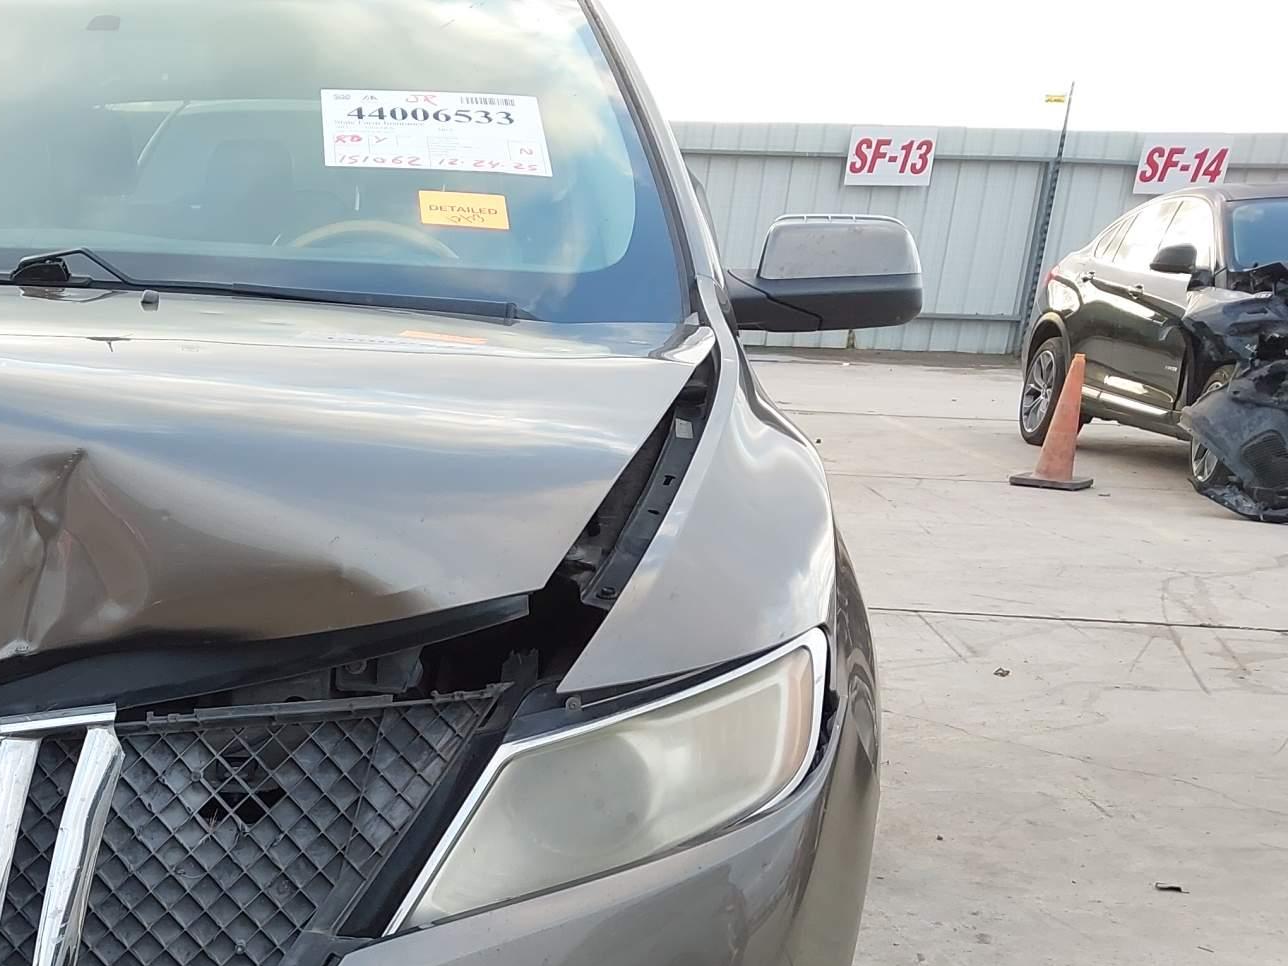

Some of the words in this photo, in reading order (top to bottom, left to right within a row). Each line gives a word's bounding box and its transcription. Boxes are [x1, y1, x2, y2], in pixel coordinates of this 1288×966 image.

[347, 106, 515, 126] 44006533
[849, 138, 933, 175] SF-13
[1139, 147, 1229, 183] SF-14
[429, 204, 498, 215] DETAILED
